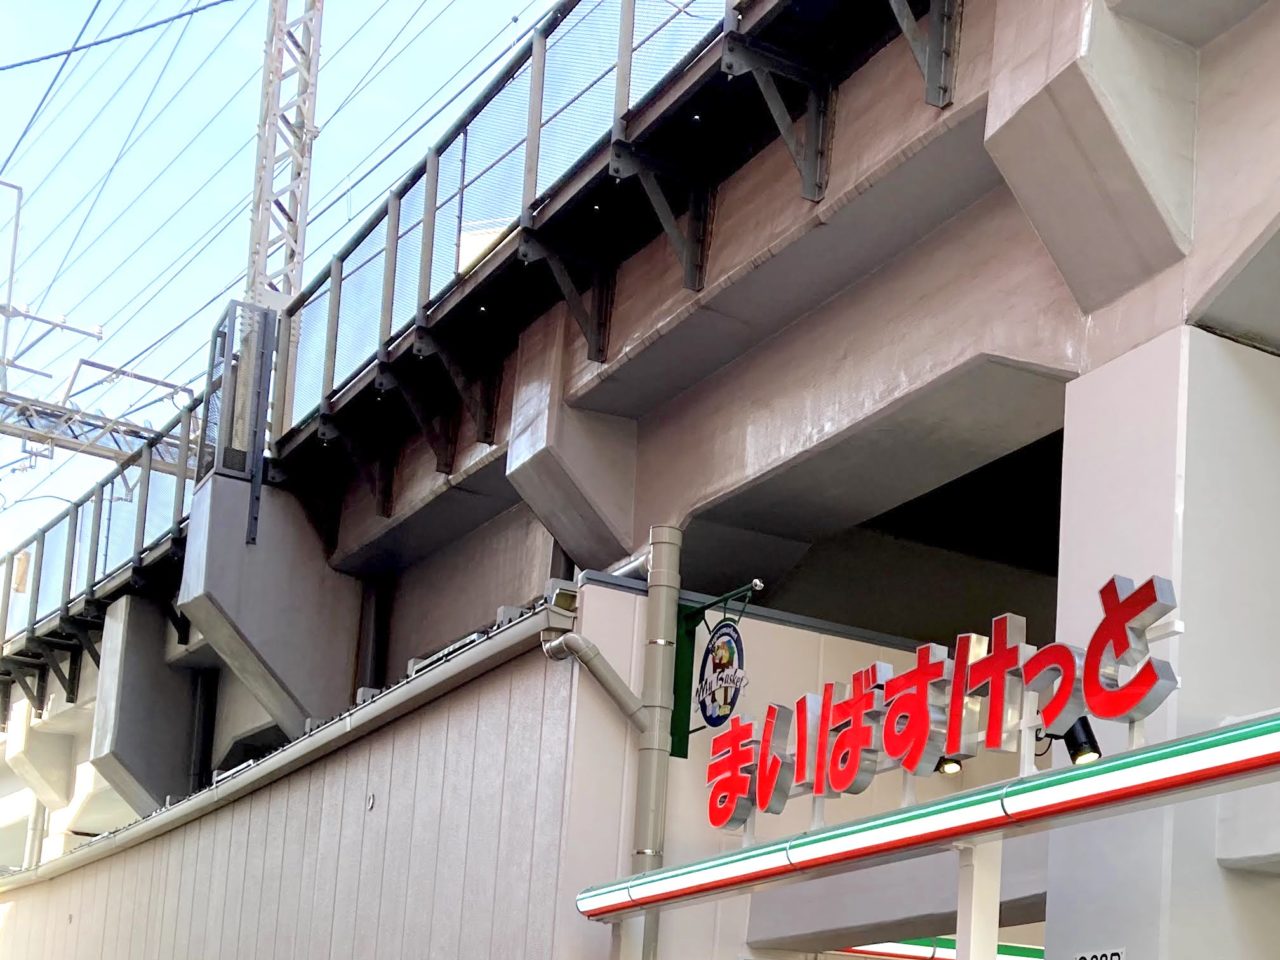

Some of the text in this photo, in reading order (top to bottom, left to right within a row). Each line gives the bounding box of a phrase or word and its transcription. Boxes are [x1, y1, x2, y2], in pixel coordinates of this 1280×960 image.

[706, 574, 1178, 830] まいばすけっと
